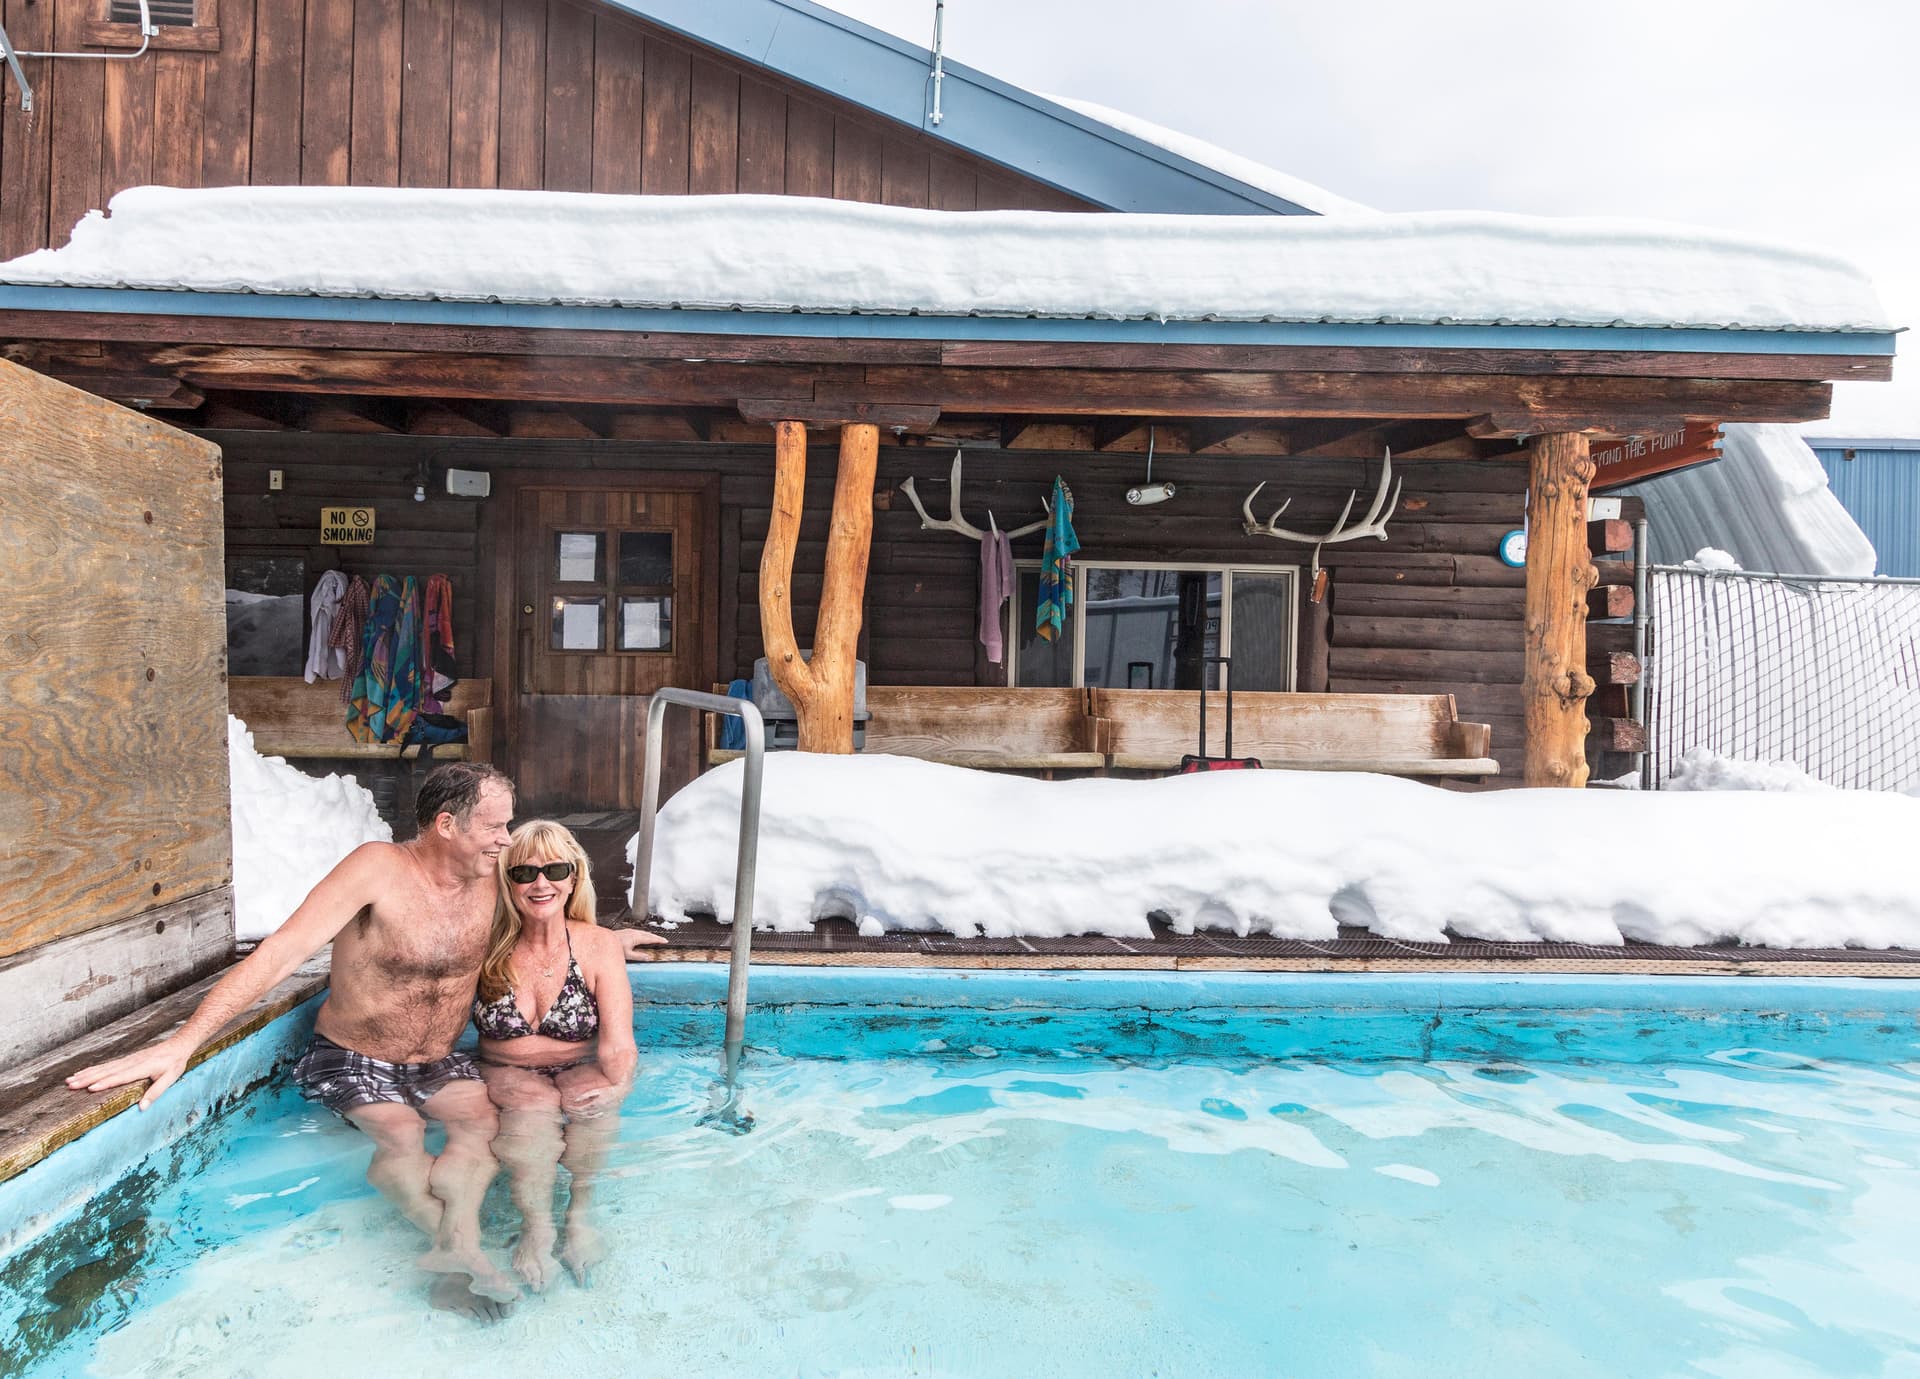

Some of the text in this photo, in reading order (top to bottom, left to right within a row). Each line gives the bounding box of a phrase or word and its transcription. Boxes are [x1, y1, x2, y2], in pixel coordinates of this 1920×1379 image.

[1590, 428, 1686, 468] EYOND THIS POINT
[331, 511, 346, 525] NO
[323, 527, 373, 541] SMOKING
